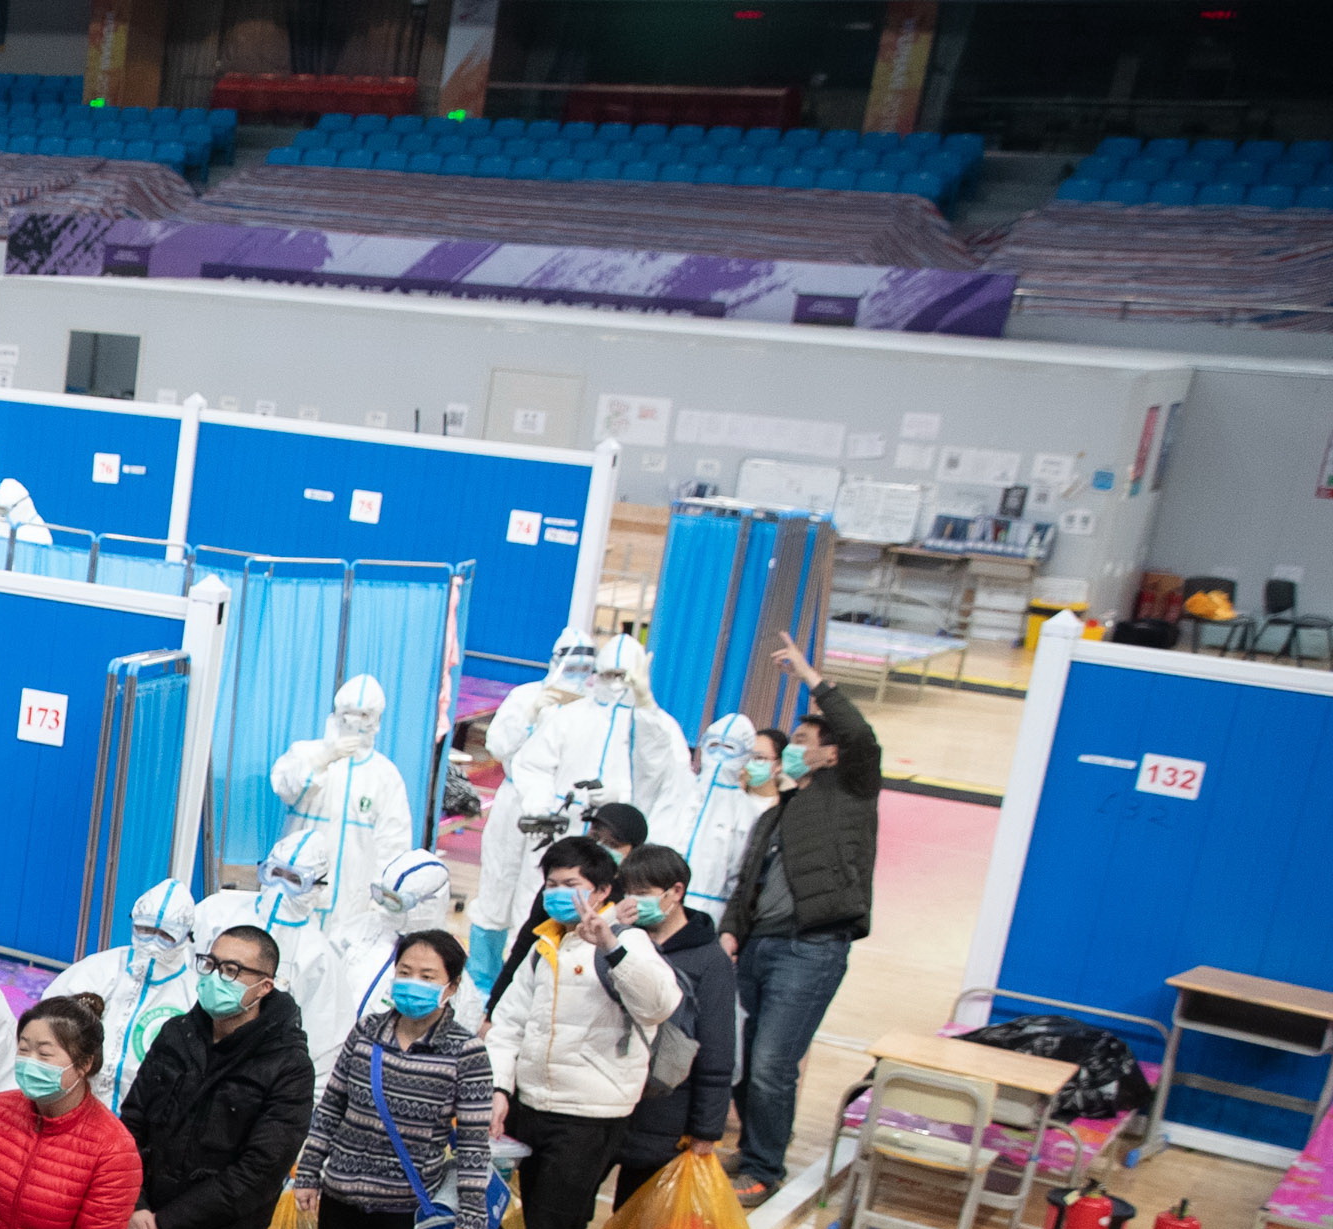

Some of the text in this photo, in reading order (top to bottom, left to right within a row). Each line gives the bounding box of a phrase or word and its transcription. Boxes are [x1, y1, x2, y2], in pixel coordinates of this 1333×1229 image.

[516, 520, 533, 535] 74
[26, 705, 61, 730] 173
[1148, 764, 1198, 791] 132
